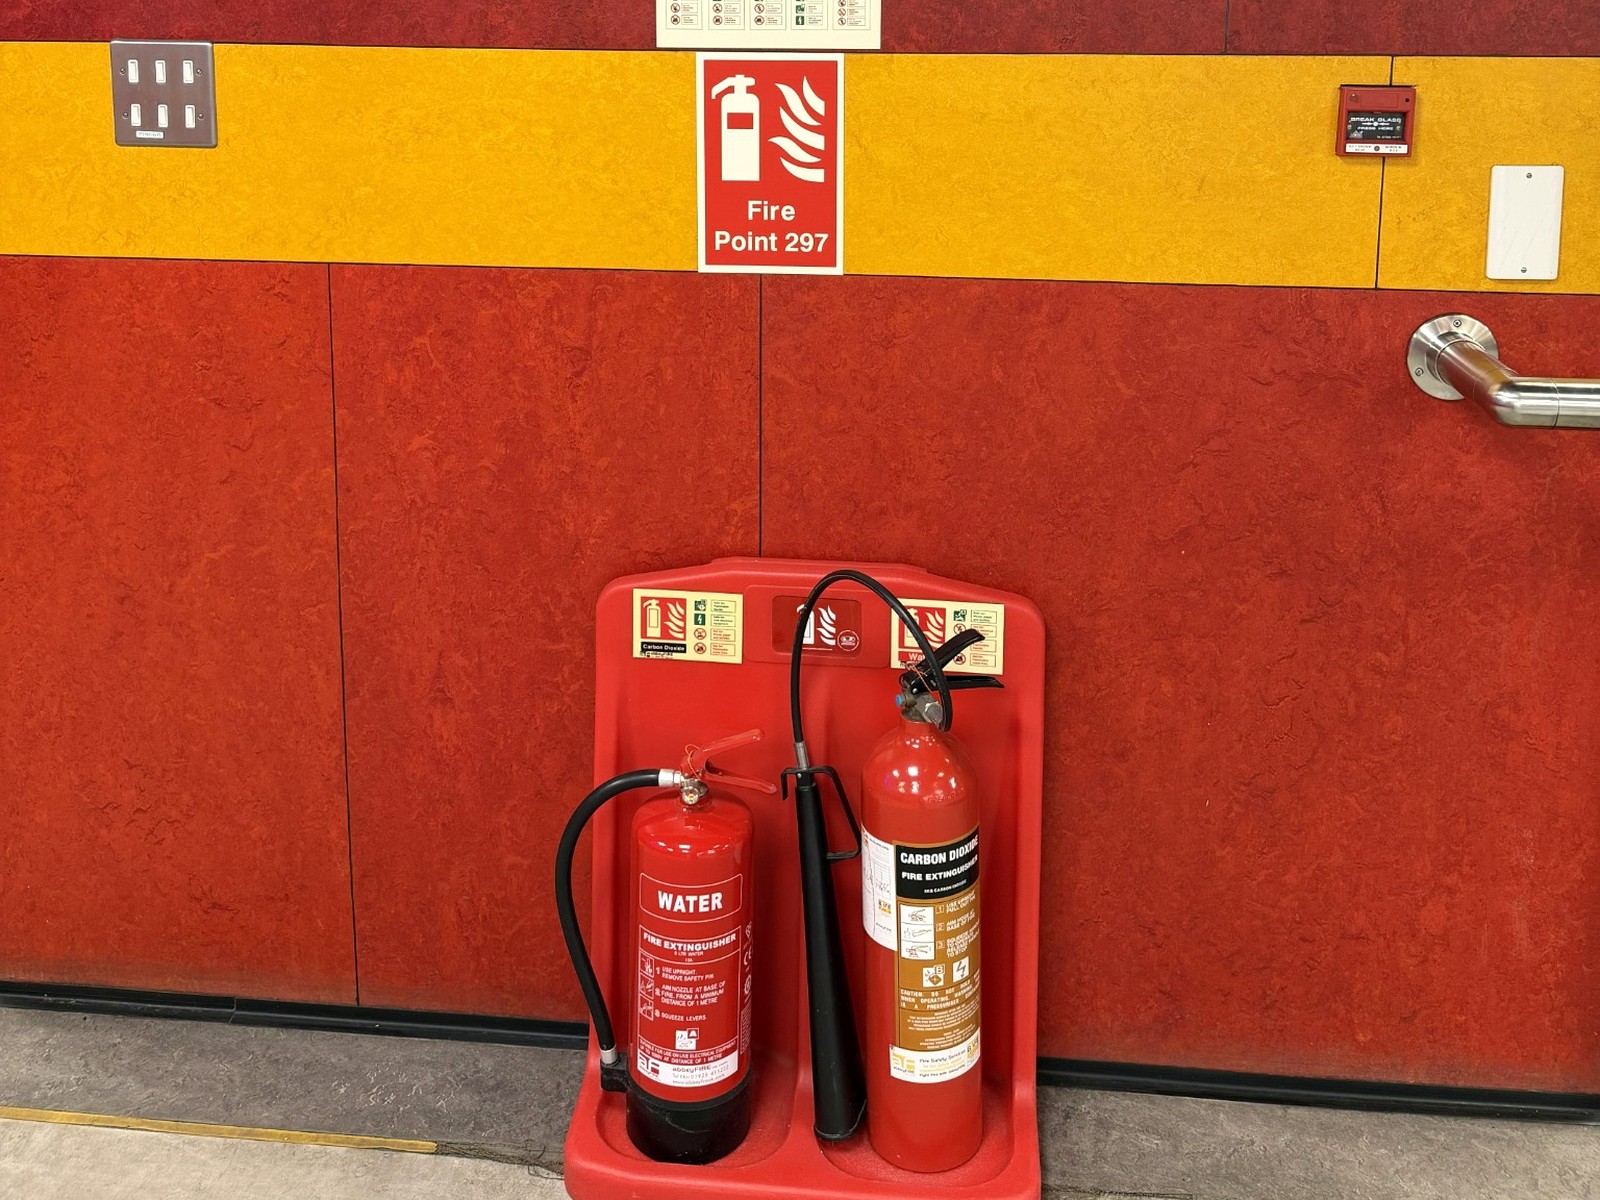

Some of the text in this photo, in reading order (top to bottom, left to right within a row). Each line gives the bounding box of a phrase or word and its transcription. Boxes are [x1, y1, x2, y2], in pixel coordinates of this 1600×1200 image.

[748, 200, 796, 220] Fire
[714, 230, 829, 252] Point 297
[900, 834, 978, 865] CARBON DIOXIDE
[902, 872, 923, 880] FIRE
[926, 854, 978, 880] EXTINGUISHER
[658, 890, 722, 913] WATER
[643, 932, 662, 947] FIRE
[663, 933, 736, 952] EXTINGUISHER
[656, 967, 660, 975] 1
[662, 972, 682, 982] REMOVE
[700, 989, 725, 1000] MINIMUM
[661, 997, 686, 1006] DISTANCE
[700, 996, 718, 1005] METRE
[926, 998, 960, 1010] PRESSURISED
[662, 1012, 684, 1021] SQUEEZE
[716, 1040, 736, 1053] EQUIPMENT
[707, 1053, 723, 1061] METRE
